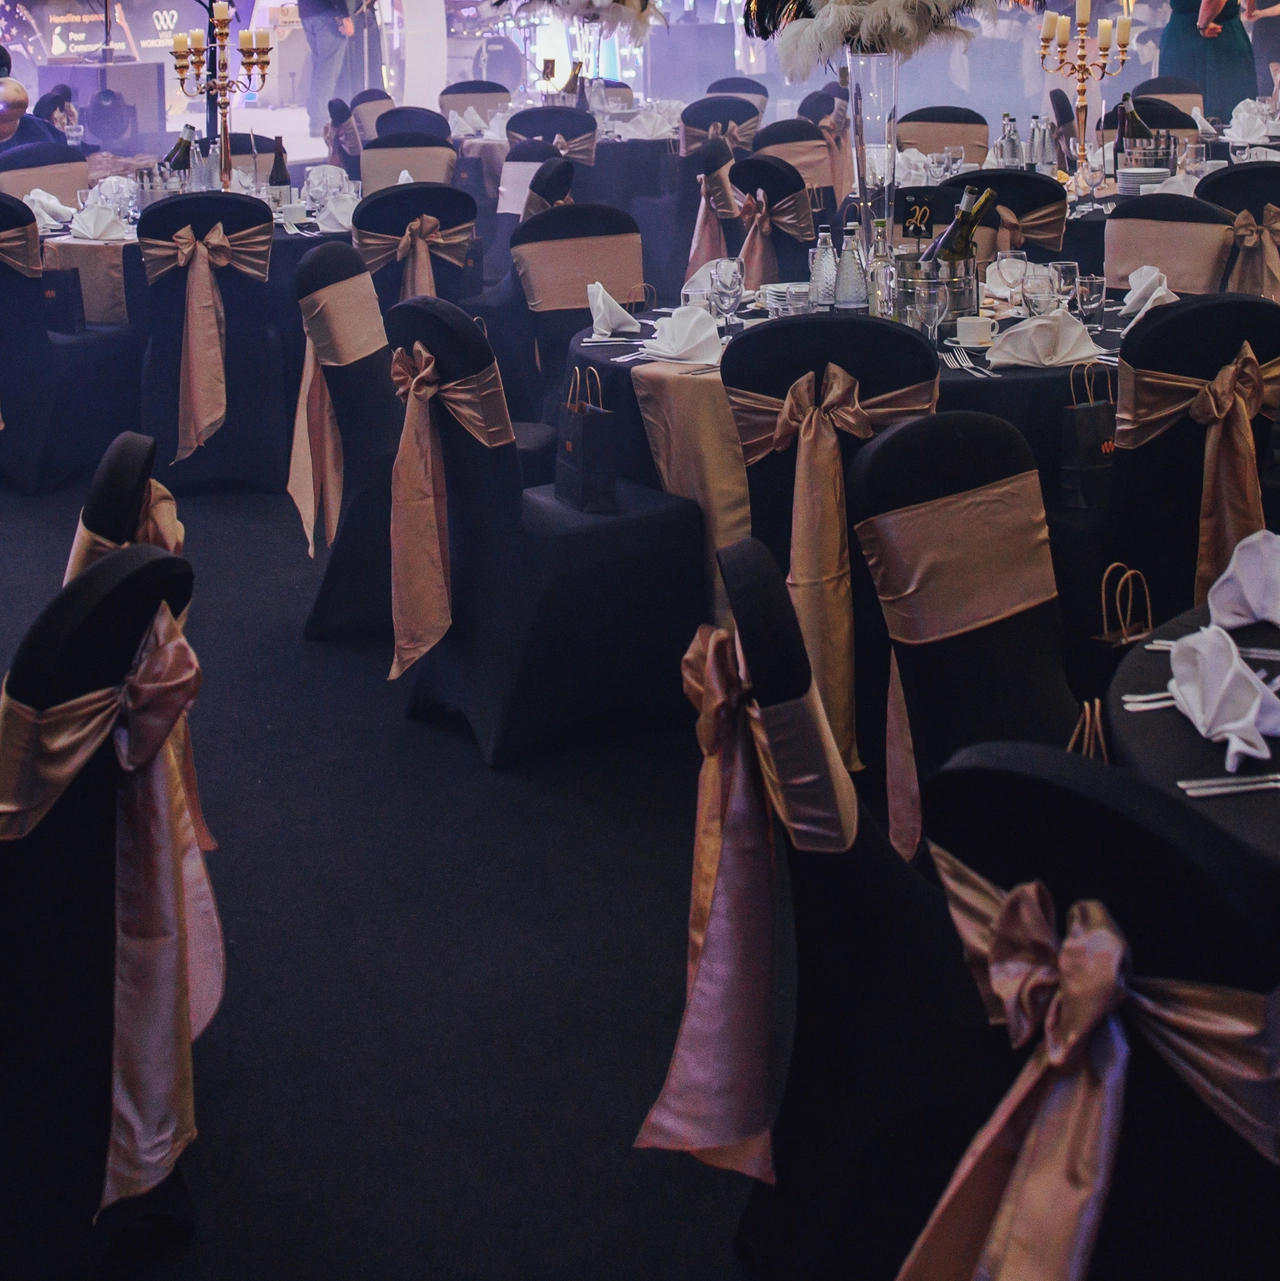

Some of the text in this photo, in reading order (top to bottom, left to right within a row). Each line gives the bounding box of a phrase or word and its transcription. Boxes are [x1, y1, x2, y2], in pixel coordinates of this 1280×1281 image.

[49, 13, 81, 24] Headline
[68, 31, 86, 41] Pear
[905, 205, 930, 227] 20
